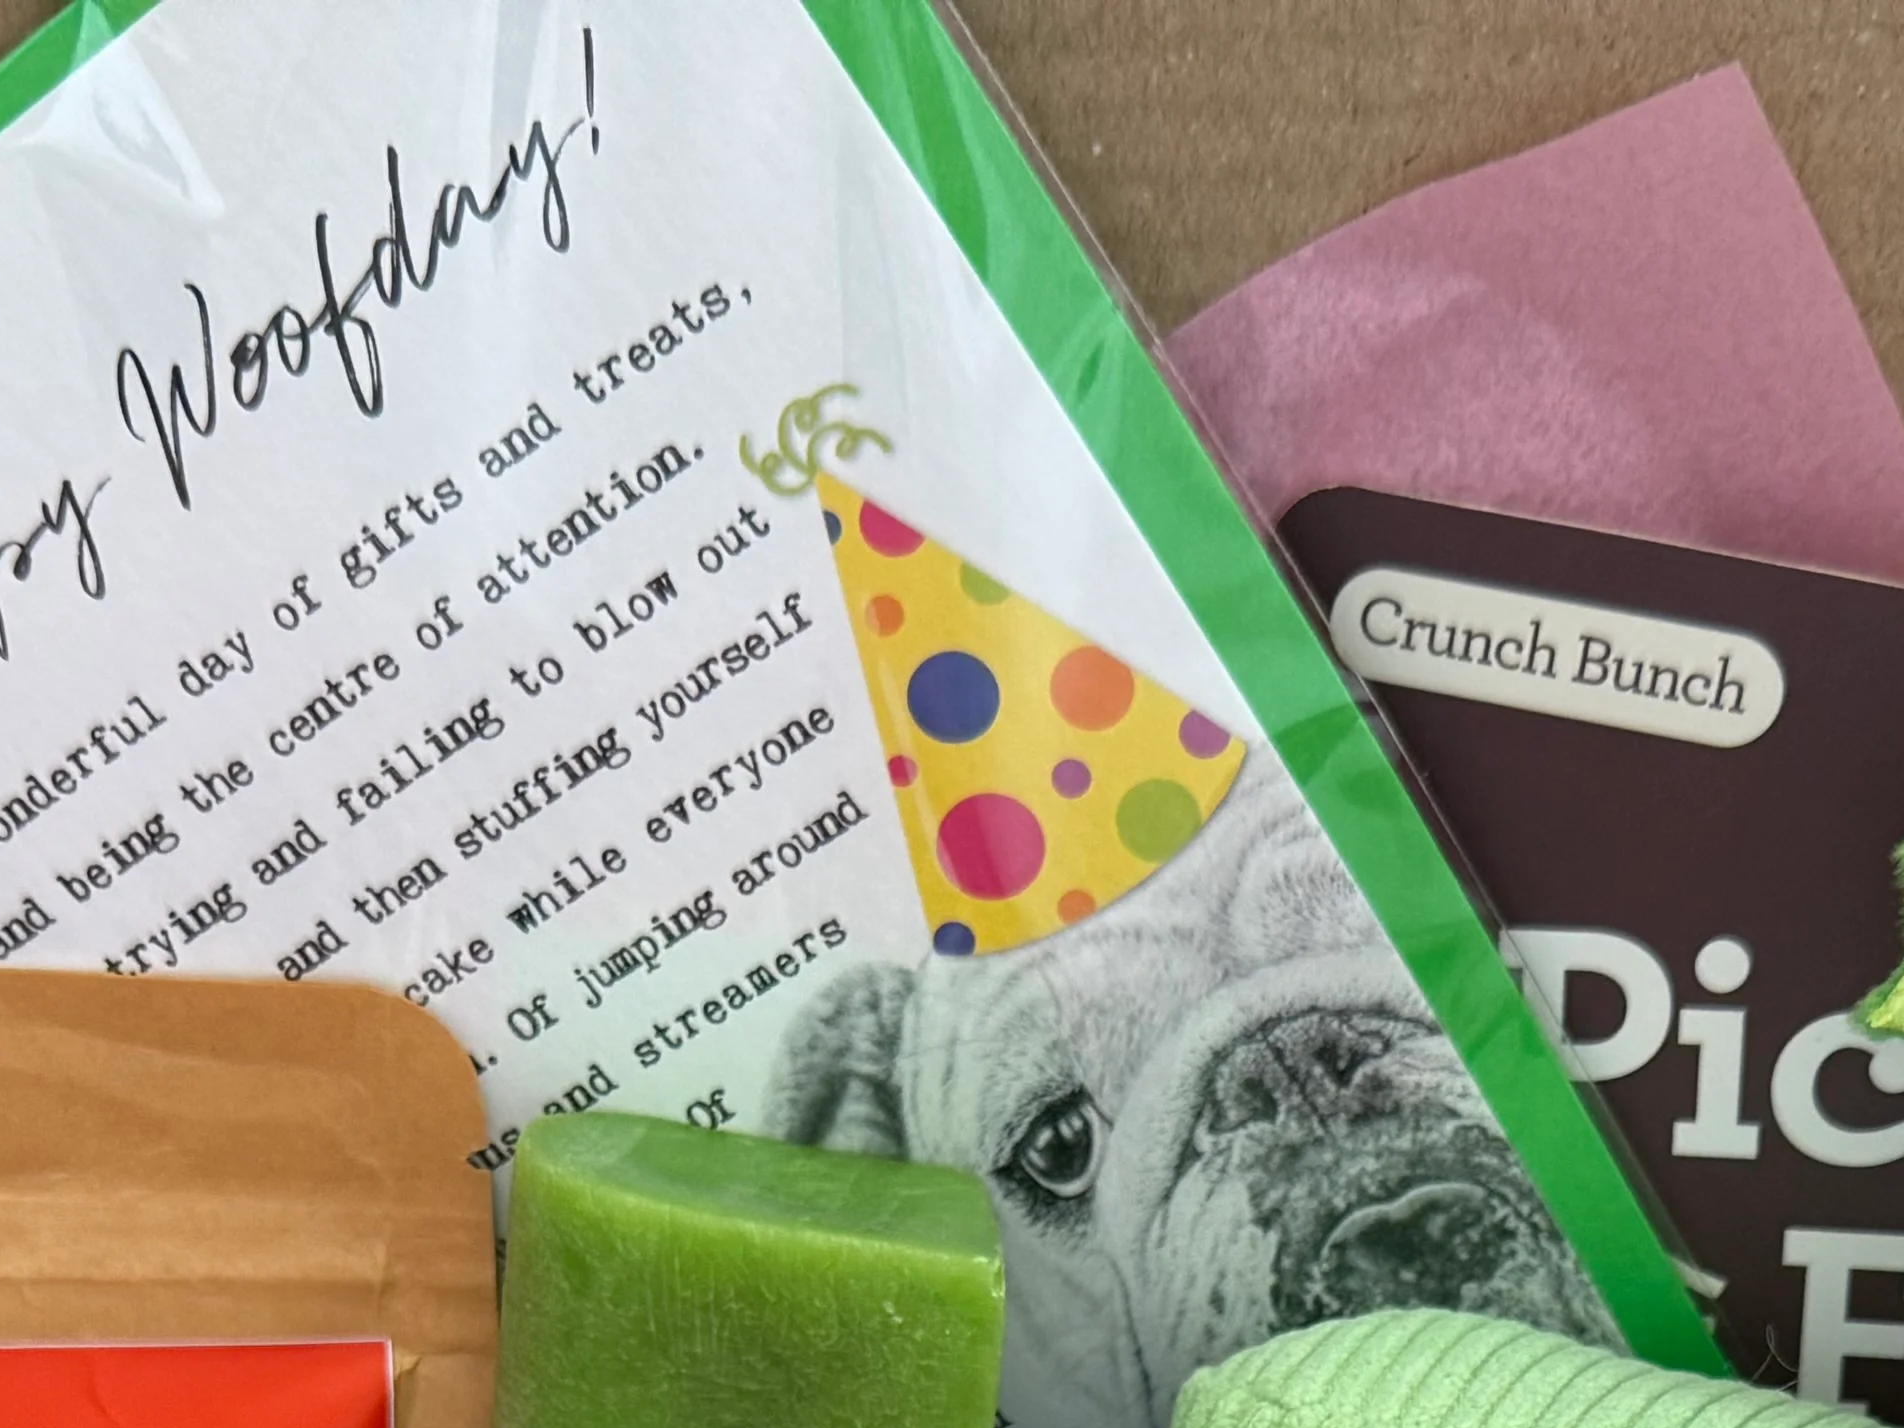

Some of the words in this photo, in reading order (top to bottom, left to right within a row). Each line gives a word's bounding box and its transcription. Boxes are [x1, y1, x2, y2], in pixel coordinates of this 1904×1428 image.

[116, 27, 599, 509] Woofday!
[178, 630, 255, 696] day
[273, 575, 322, 630] of
[340, 477, 463, 588] gifts
[478, 404, 562, 478] and
[573, 283, 752, 404] treats,
[1358, 598, 1557, 678] Crunch
[1572, 637, 1746, 714] Bunch
[57, 814, 180, 902] being
[180, 760, 255, 814] the
[268, 652, 401, 756] centre
[416, 596, 464, 650] of
[476, 440, 705, 604] attention.
[105, 883, 248, 977] trying
[251, 821, 328, 885] and
[336, 697, 505, 826] failing
[509, 657, 565, 698] to
[573, 570, 680, 652] blow
[697, 505, 772, 574] out
[276, 920, 350, 983] and
[353, 857, 448, 925] then
[454, 726, 632, 860] stuffing
[636, 592, 813, 741] yourself
[403, 934, 495, 1008] cake
[507, 846, 627, 935] while
[646, 706, 835, 845] everyone
[507, 994, 560, 1044] Of
[573, 889, 727, 1008] jumping
[731, 791, 869, 896] around
[543, 1064, 619, 1116] and
[633, 917, 848, 1068] streamers
[686, 1089, 736, 1131] Of
